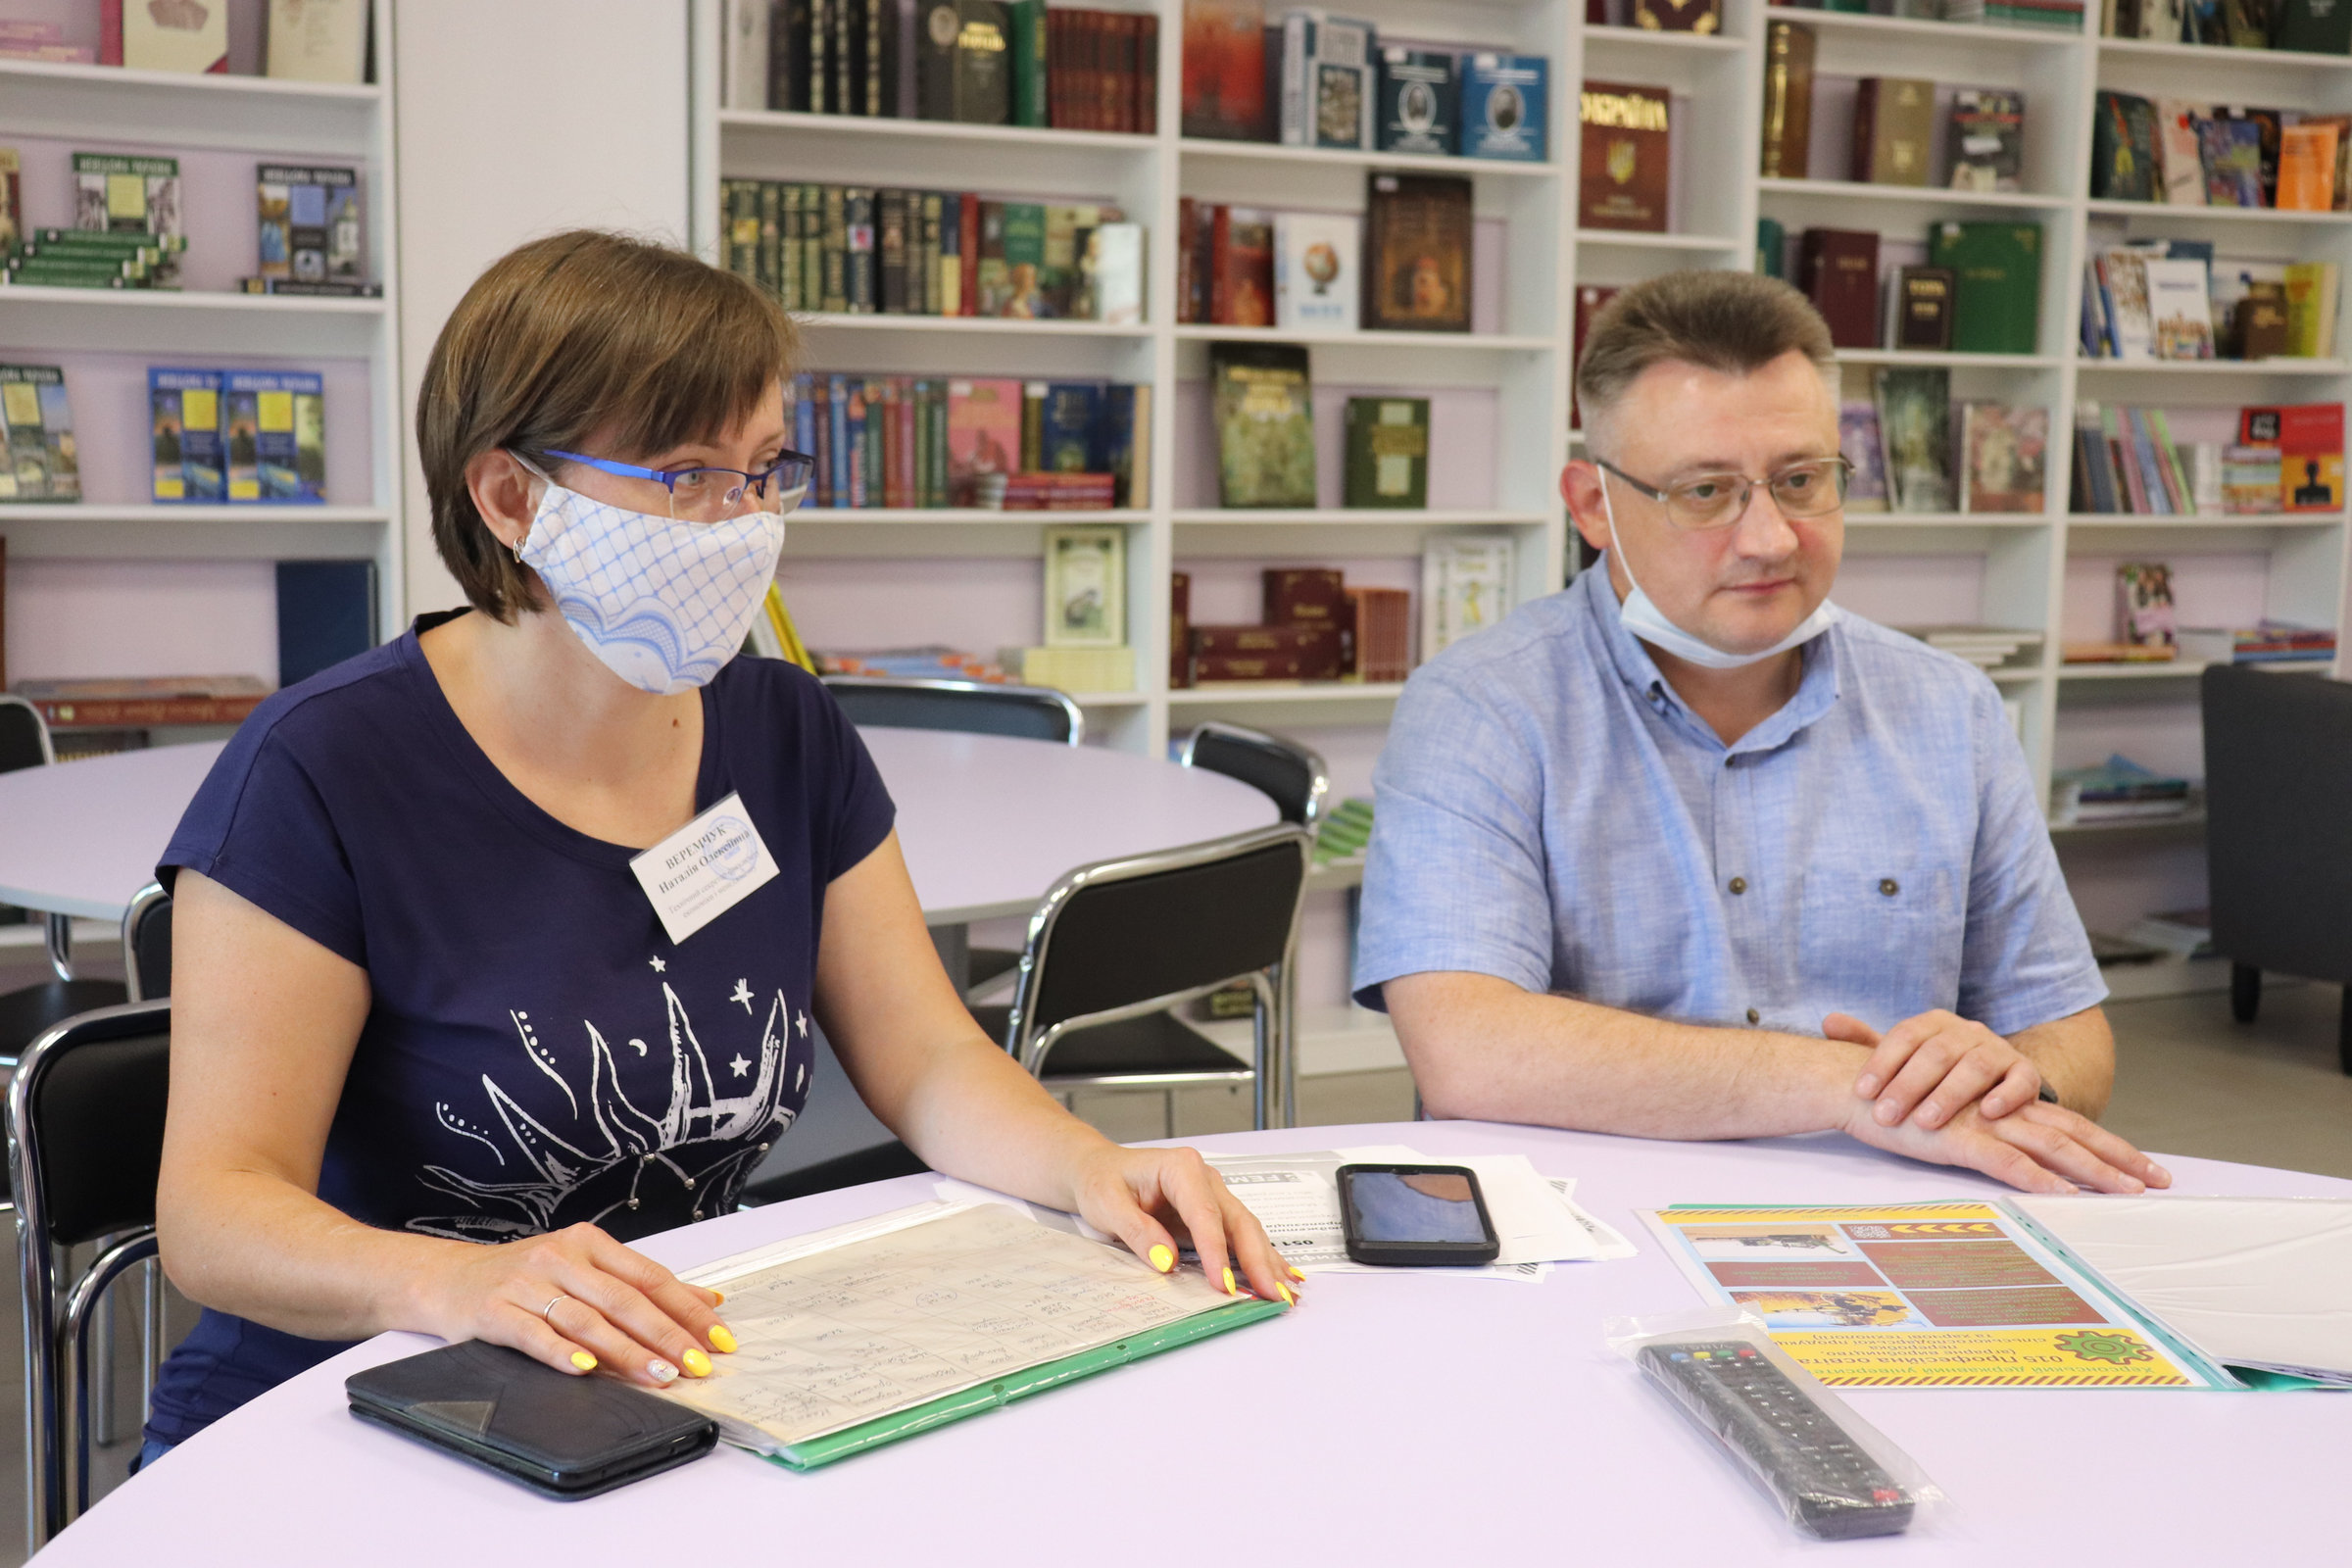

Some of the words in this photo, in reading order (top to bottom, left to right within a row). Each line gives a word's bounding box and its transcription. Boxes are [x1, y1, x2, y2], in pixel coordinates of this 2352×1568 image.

[665, 823, 727, 870] ВЕРЕМЧУК
[658, 864, 699, 894] Наталія
[1878, 1355, 2019, 1365] Професійна
[1923, 1365, 2026, 1375] державний
